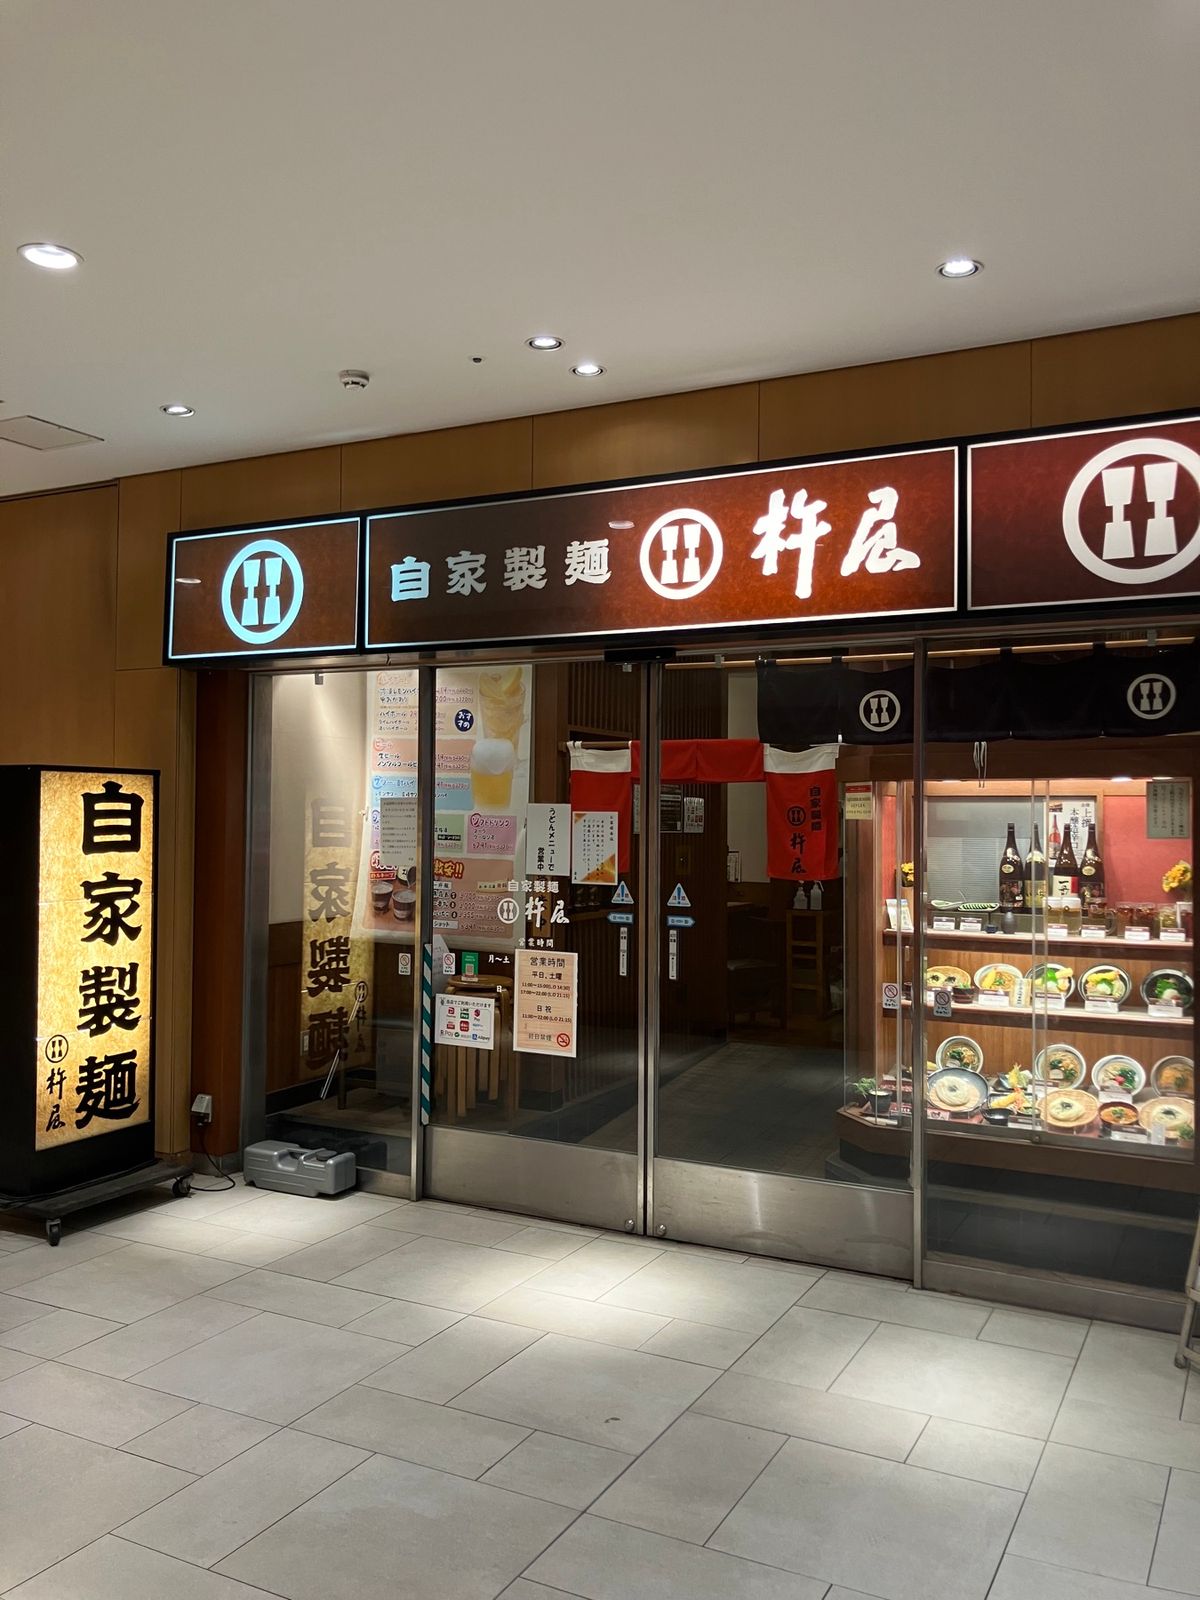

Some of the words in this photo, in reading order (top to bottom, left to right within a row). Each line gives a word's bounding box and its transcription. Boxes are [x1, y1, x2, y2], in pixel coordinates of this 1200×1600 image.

[390, 538, 612, 602] 自家製麺
[751, 487, 922, 599] 杵屋
[808, 786, 823, 831] 自家製麺
[537, 846, 545, 871] 営業中
[547, 807, 556, 872] うどんメニューで
[790, 832, 807, 874] 杵屋
[508, 880, 559, 893] 自家製麺
[525, 896, 570, 928] 杵屋
[75, 780, 145, 1130] 自家製麺
[529, 956, 566, 969] 営業時間
[531, 970, 563, 981] 平日、土曜
[45, 1067, 67, 1132] 杵屋
